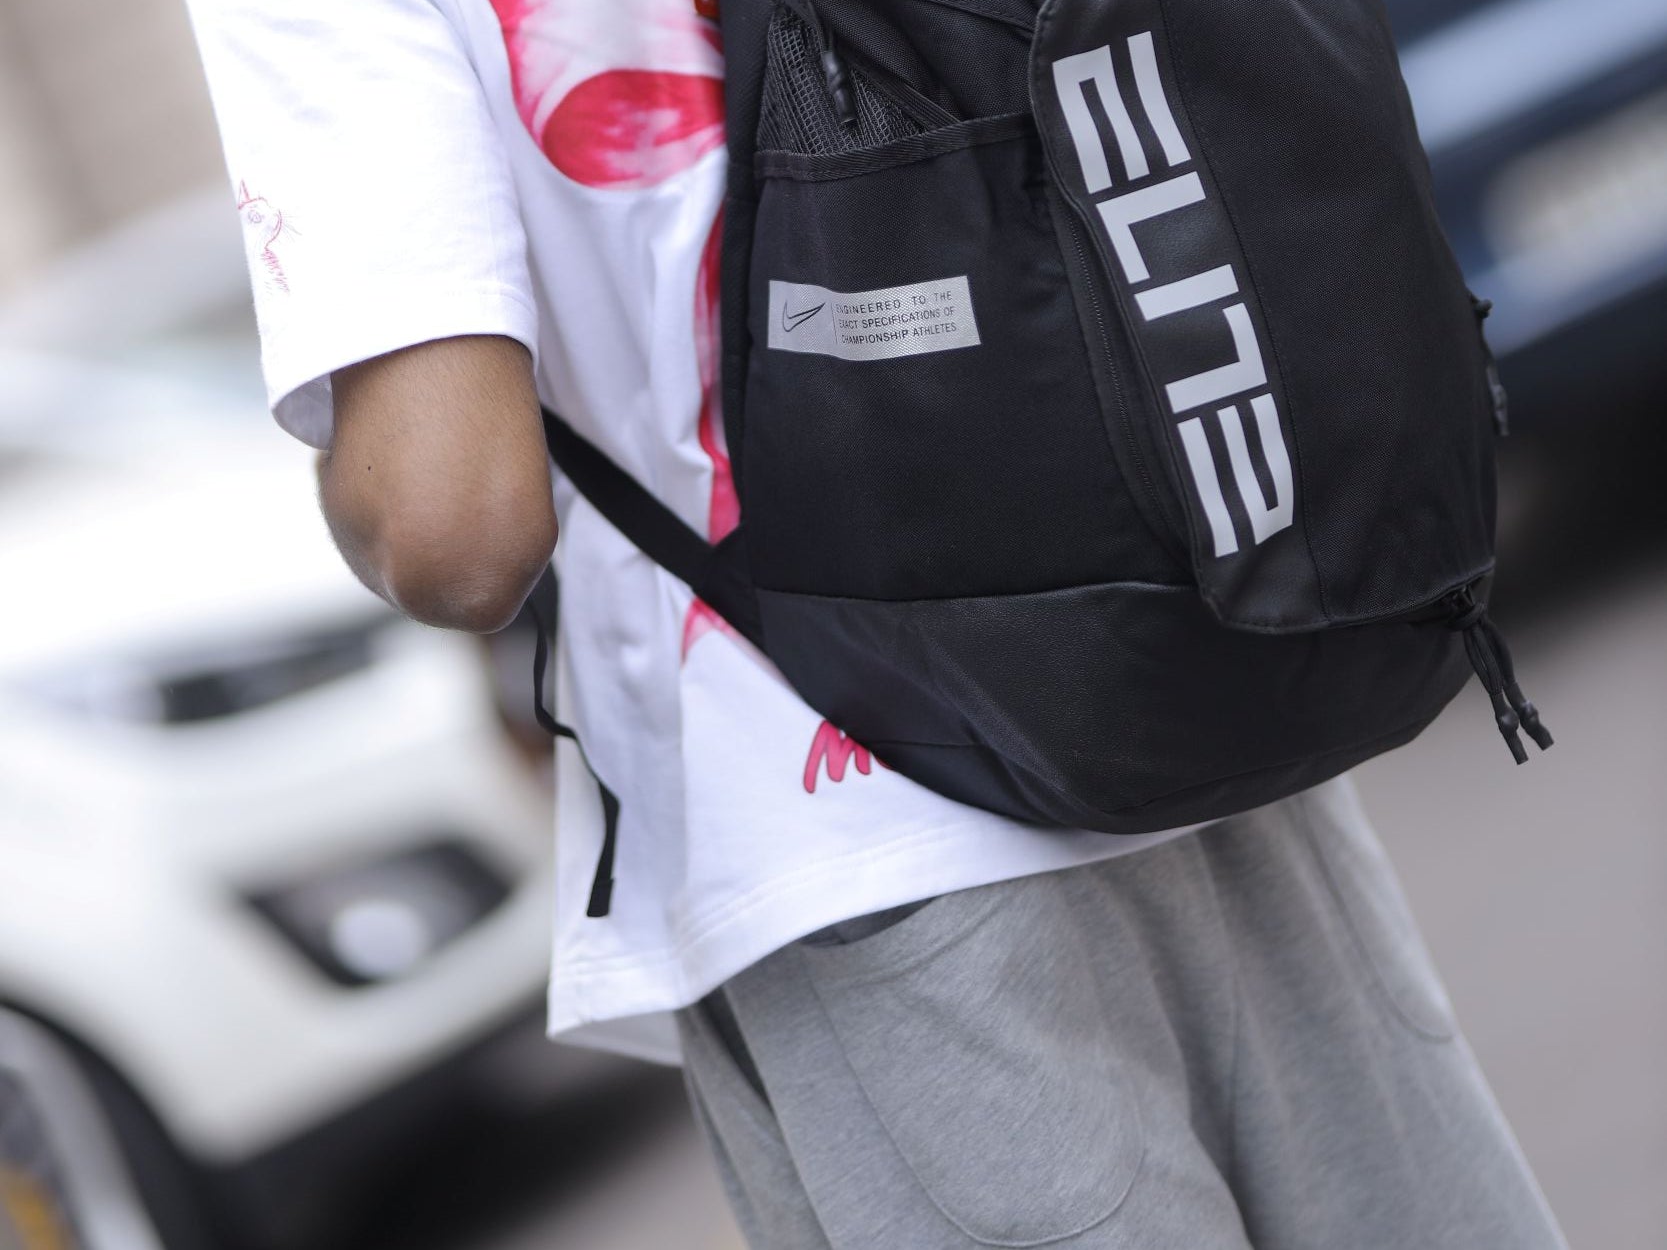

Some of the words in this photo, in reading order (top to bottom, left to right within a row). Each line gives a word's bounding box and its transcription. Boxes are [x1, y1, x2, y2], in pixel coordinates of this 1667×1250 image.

[912, 295, 926, 305] TO
[934, 290, 953, 302] THE
[1052, 31, 1295, 558] ELITE
[862, 307, 940, 329] SPECIFICATIONS
[943, 306, 955, 317] OF
[841, 329, 909, 345] CHAMPIONSHIP
[913, 322, 957, 337] ATHLETES
